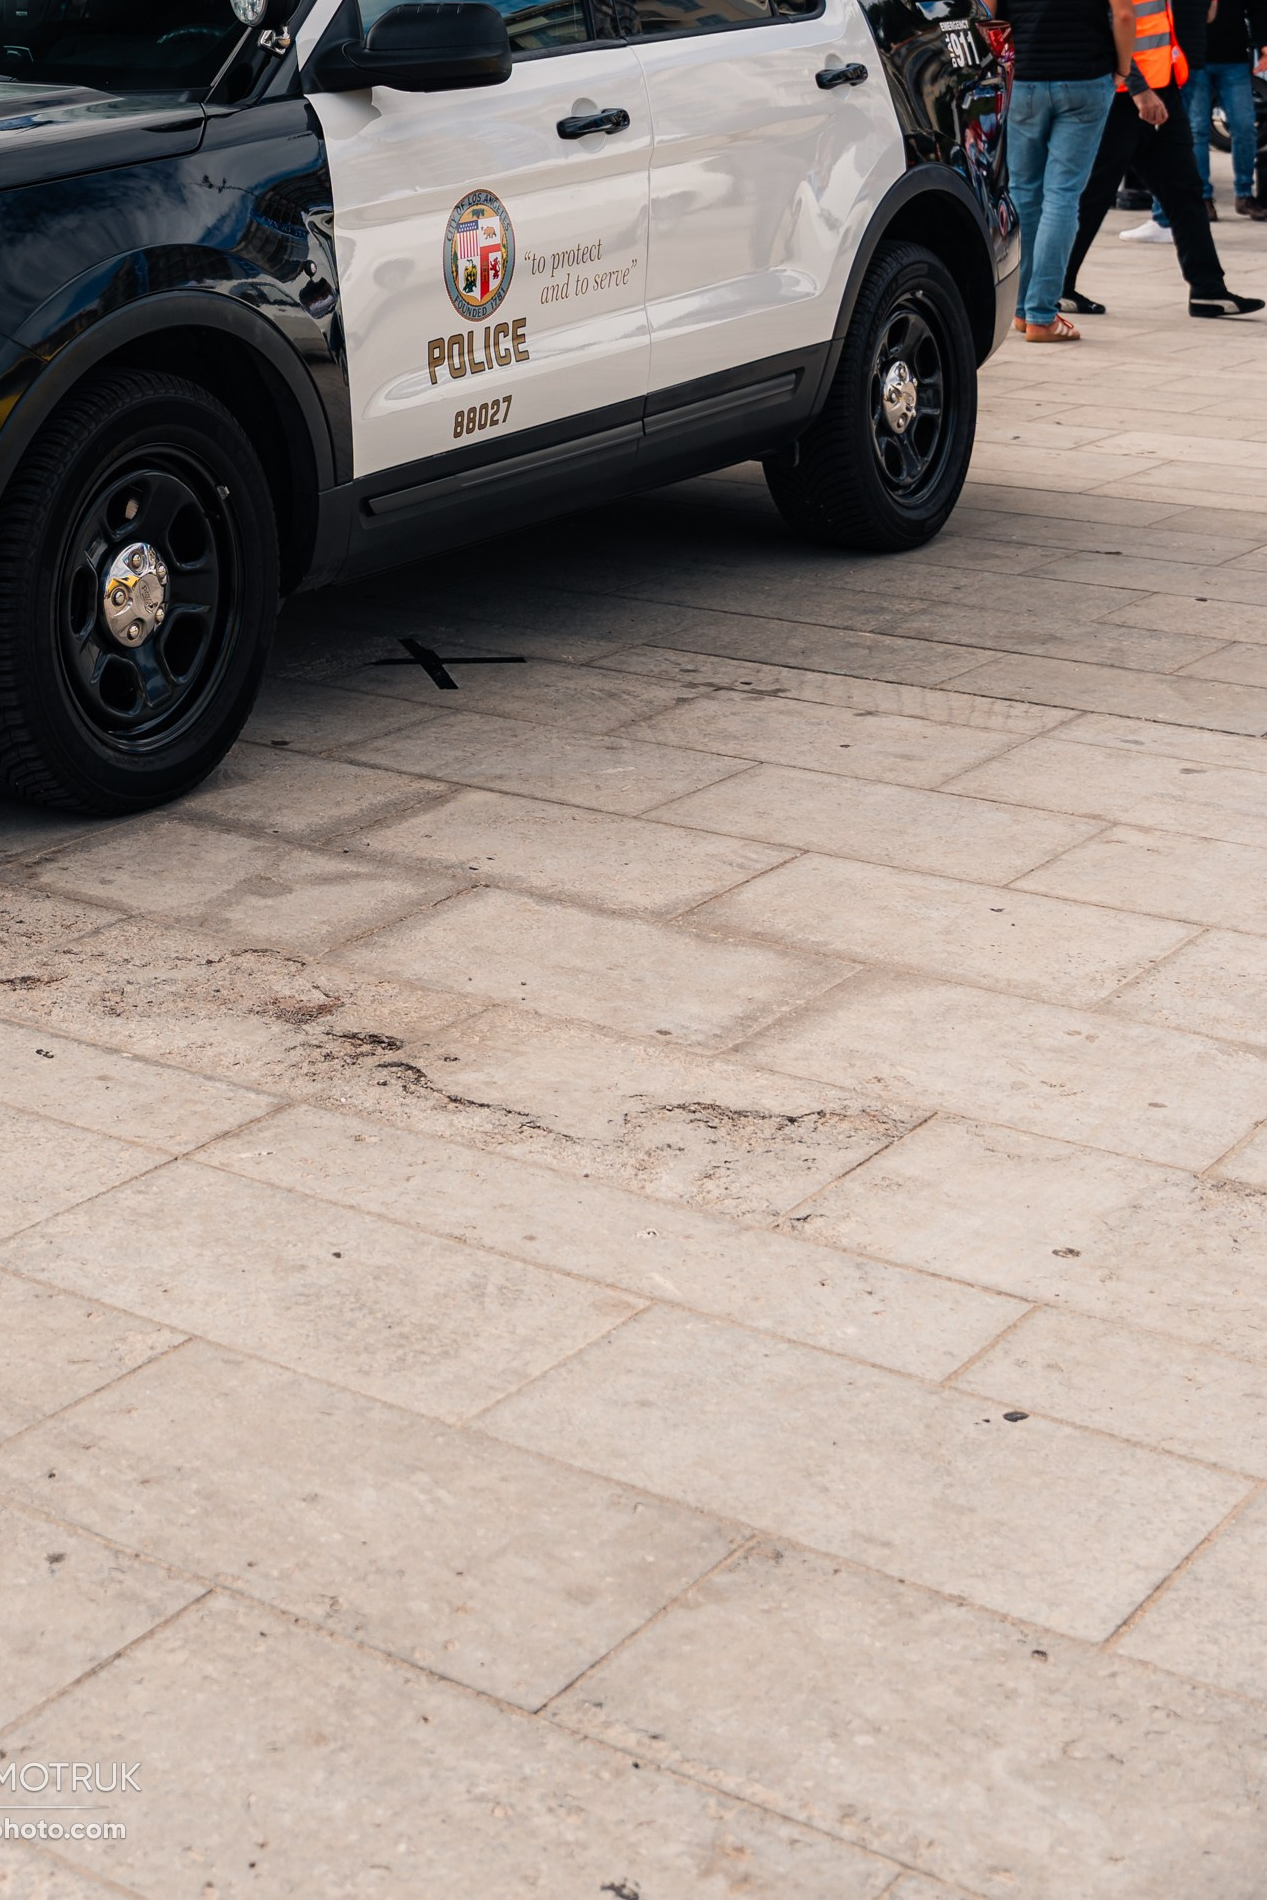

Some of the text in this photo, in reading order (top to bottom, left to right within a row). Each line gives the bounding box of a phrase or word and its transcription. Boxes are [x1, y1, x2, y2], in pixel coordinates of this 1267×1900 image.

[939, 20, 969, 31] EMERGENCY
[949, 31, 980, 68] 911
[446, 192, 511, 242] CITY OF LOS ANGELES
[550, 239, 602, 278] protect
[453, 287, 506, 318] FOUNDED 1781
[540, 273, 571, 305] and
[575, 274, 589, 297] to
[427, 317, 530, 385] POLICE
[452, 394, 513, 439] 88027
